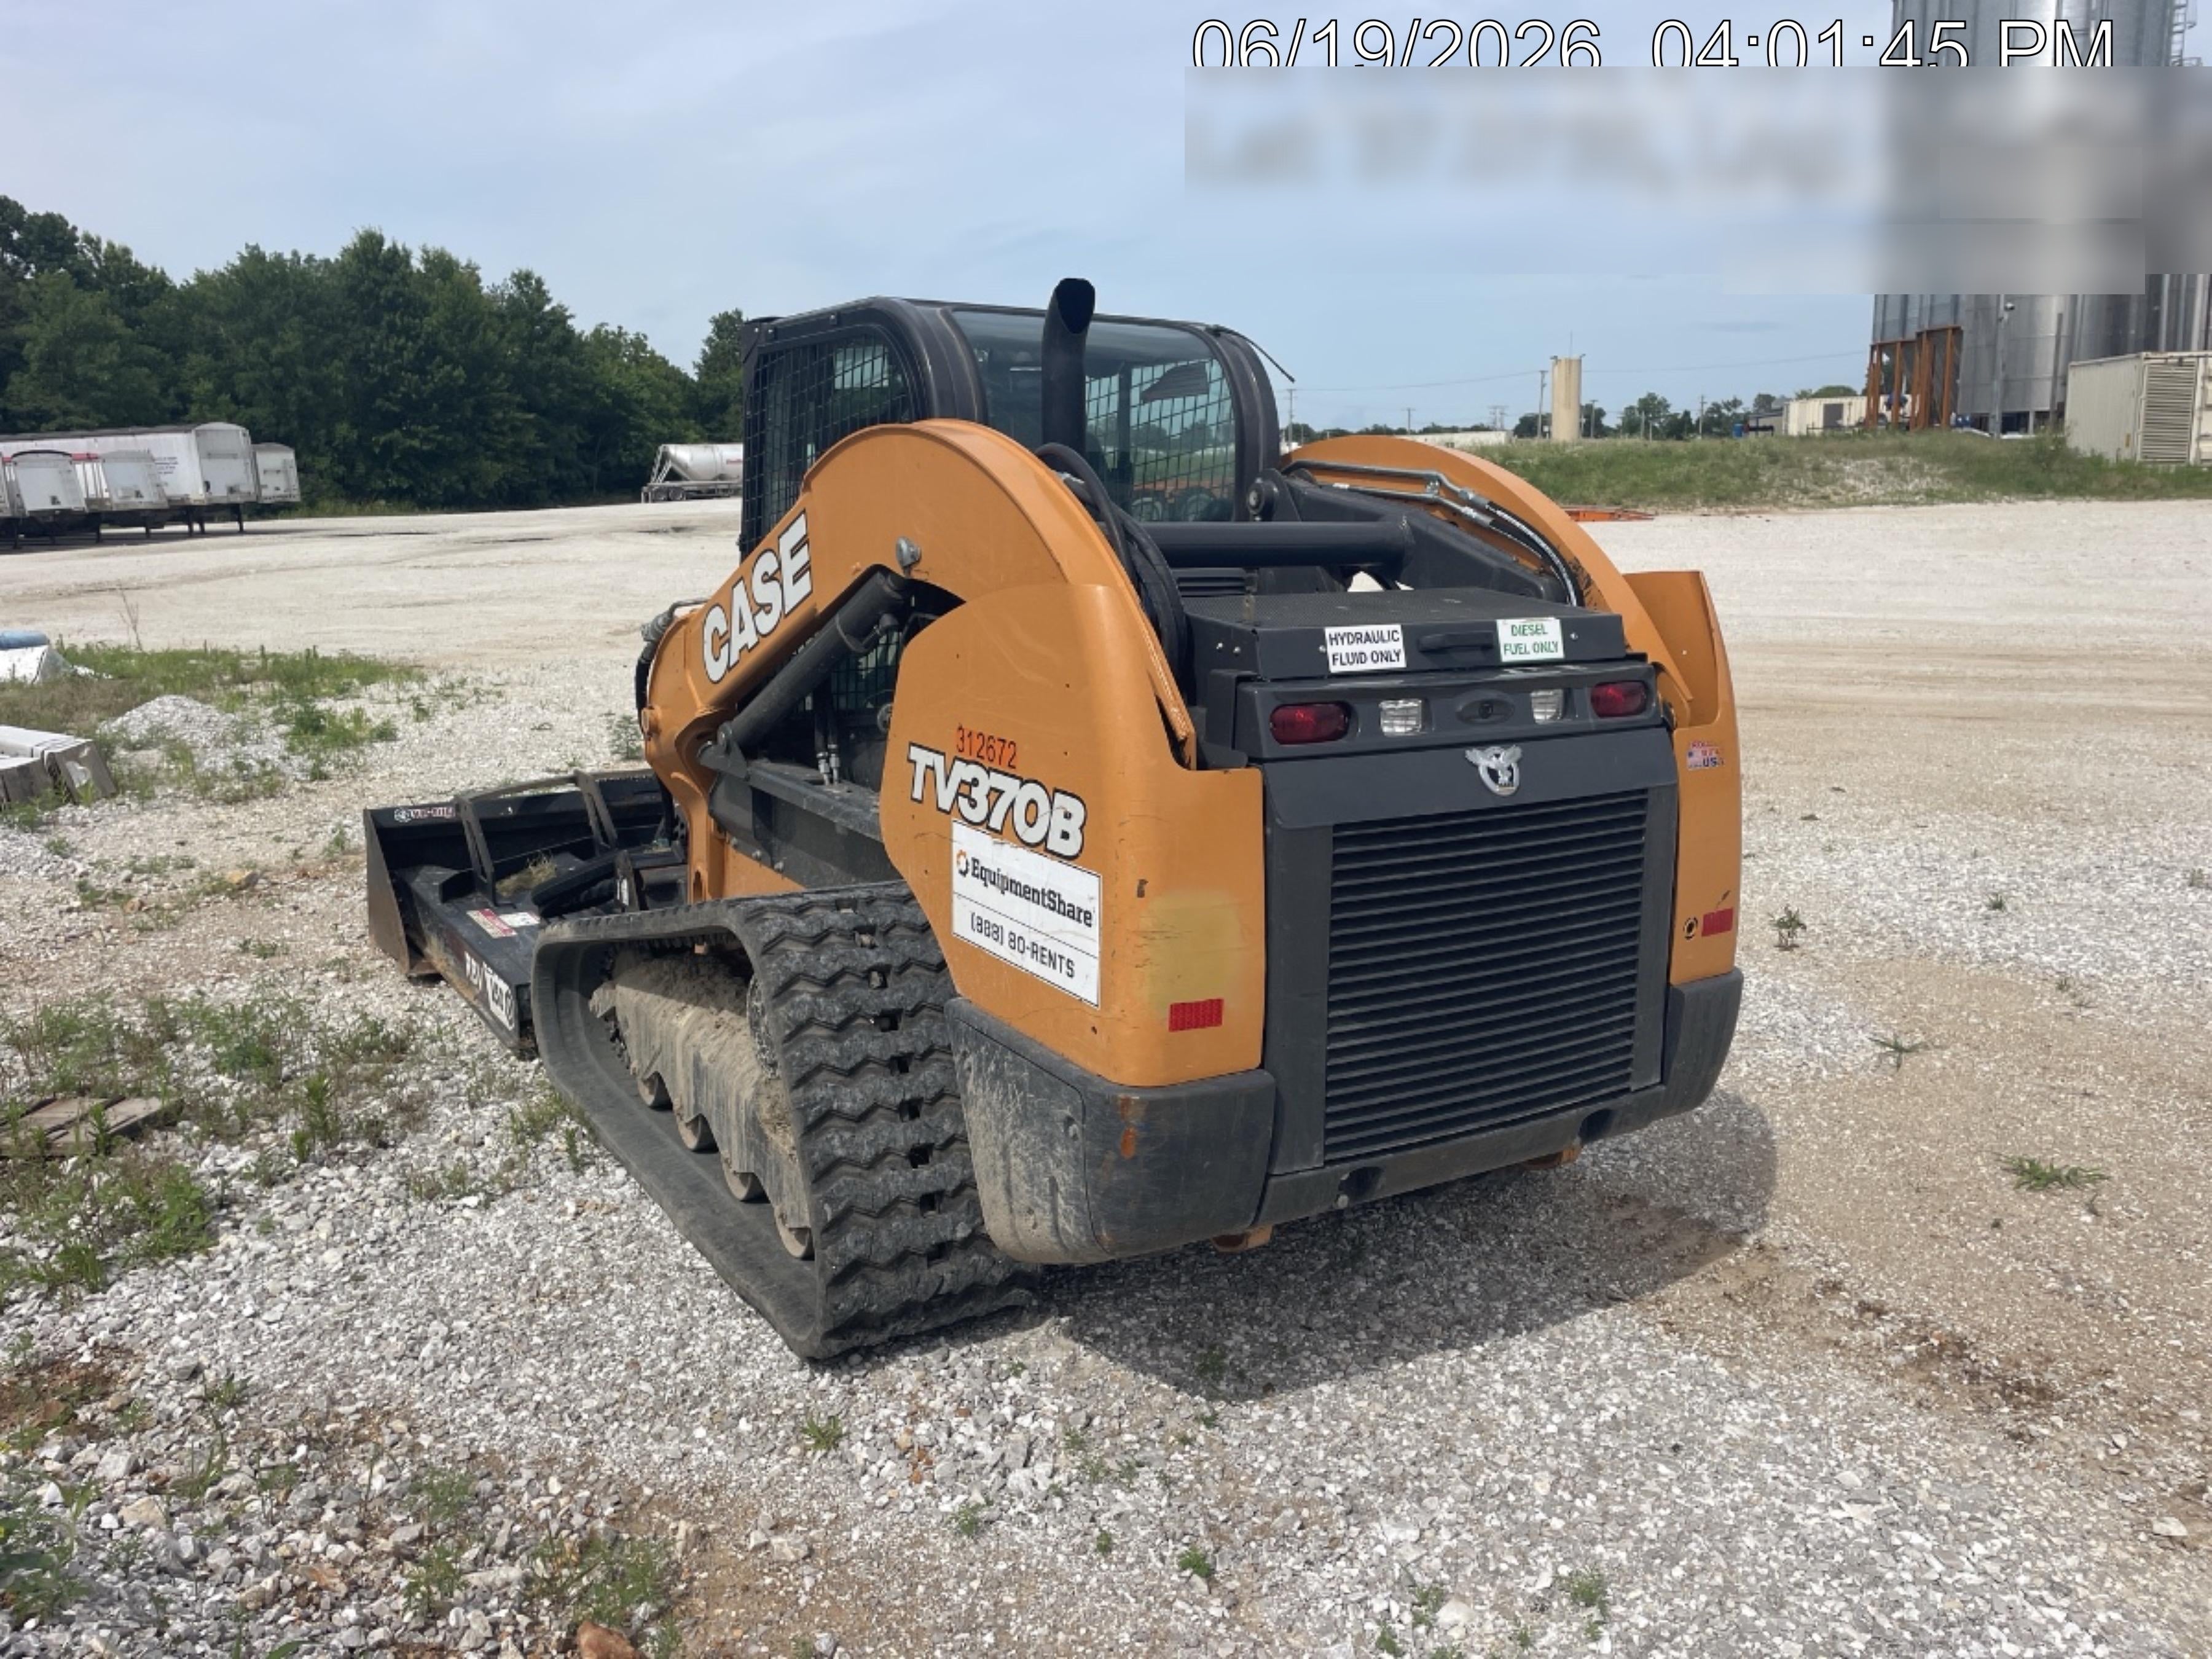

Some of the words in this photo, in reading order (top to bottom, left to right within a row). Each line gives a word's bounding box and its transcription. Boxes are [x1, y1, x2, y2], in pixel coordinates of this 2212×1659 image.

[702, 508, 813, 684] CASE
[1328, 630, 1400, 646] HYDRAULIC
[1504, 643, 1530, 655] FUEL
[1533, 641, 1559, 654] ONLY
[1511, 624, 1548, 637] DIESEL
[1332, 651, 1368, 666] FLUID
[1371, 649, 1402, 663] ONLY
[956, 726, 1017, 769] 312672
[908, 742, 1087, 860] TV370B
[971, 857, 1092, 928] EquipmentShare
[970, 912, 1004, 946] (888)
[1008, 930, 1075, 978] 80-RENTS
